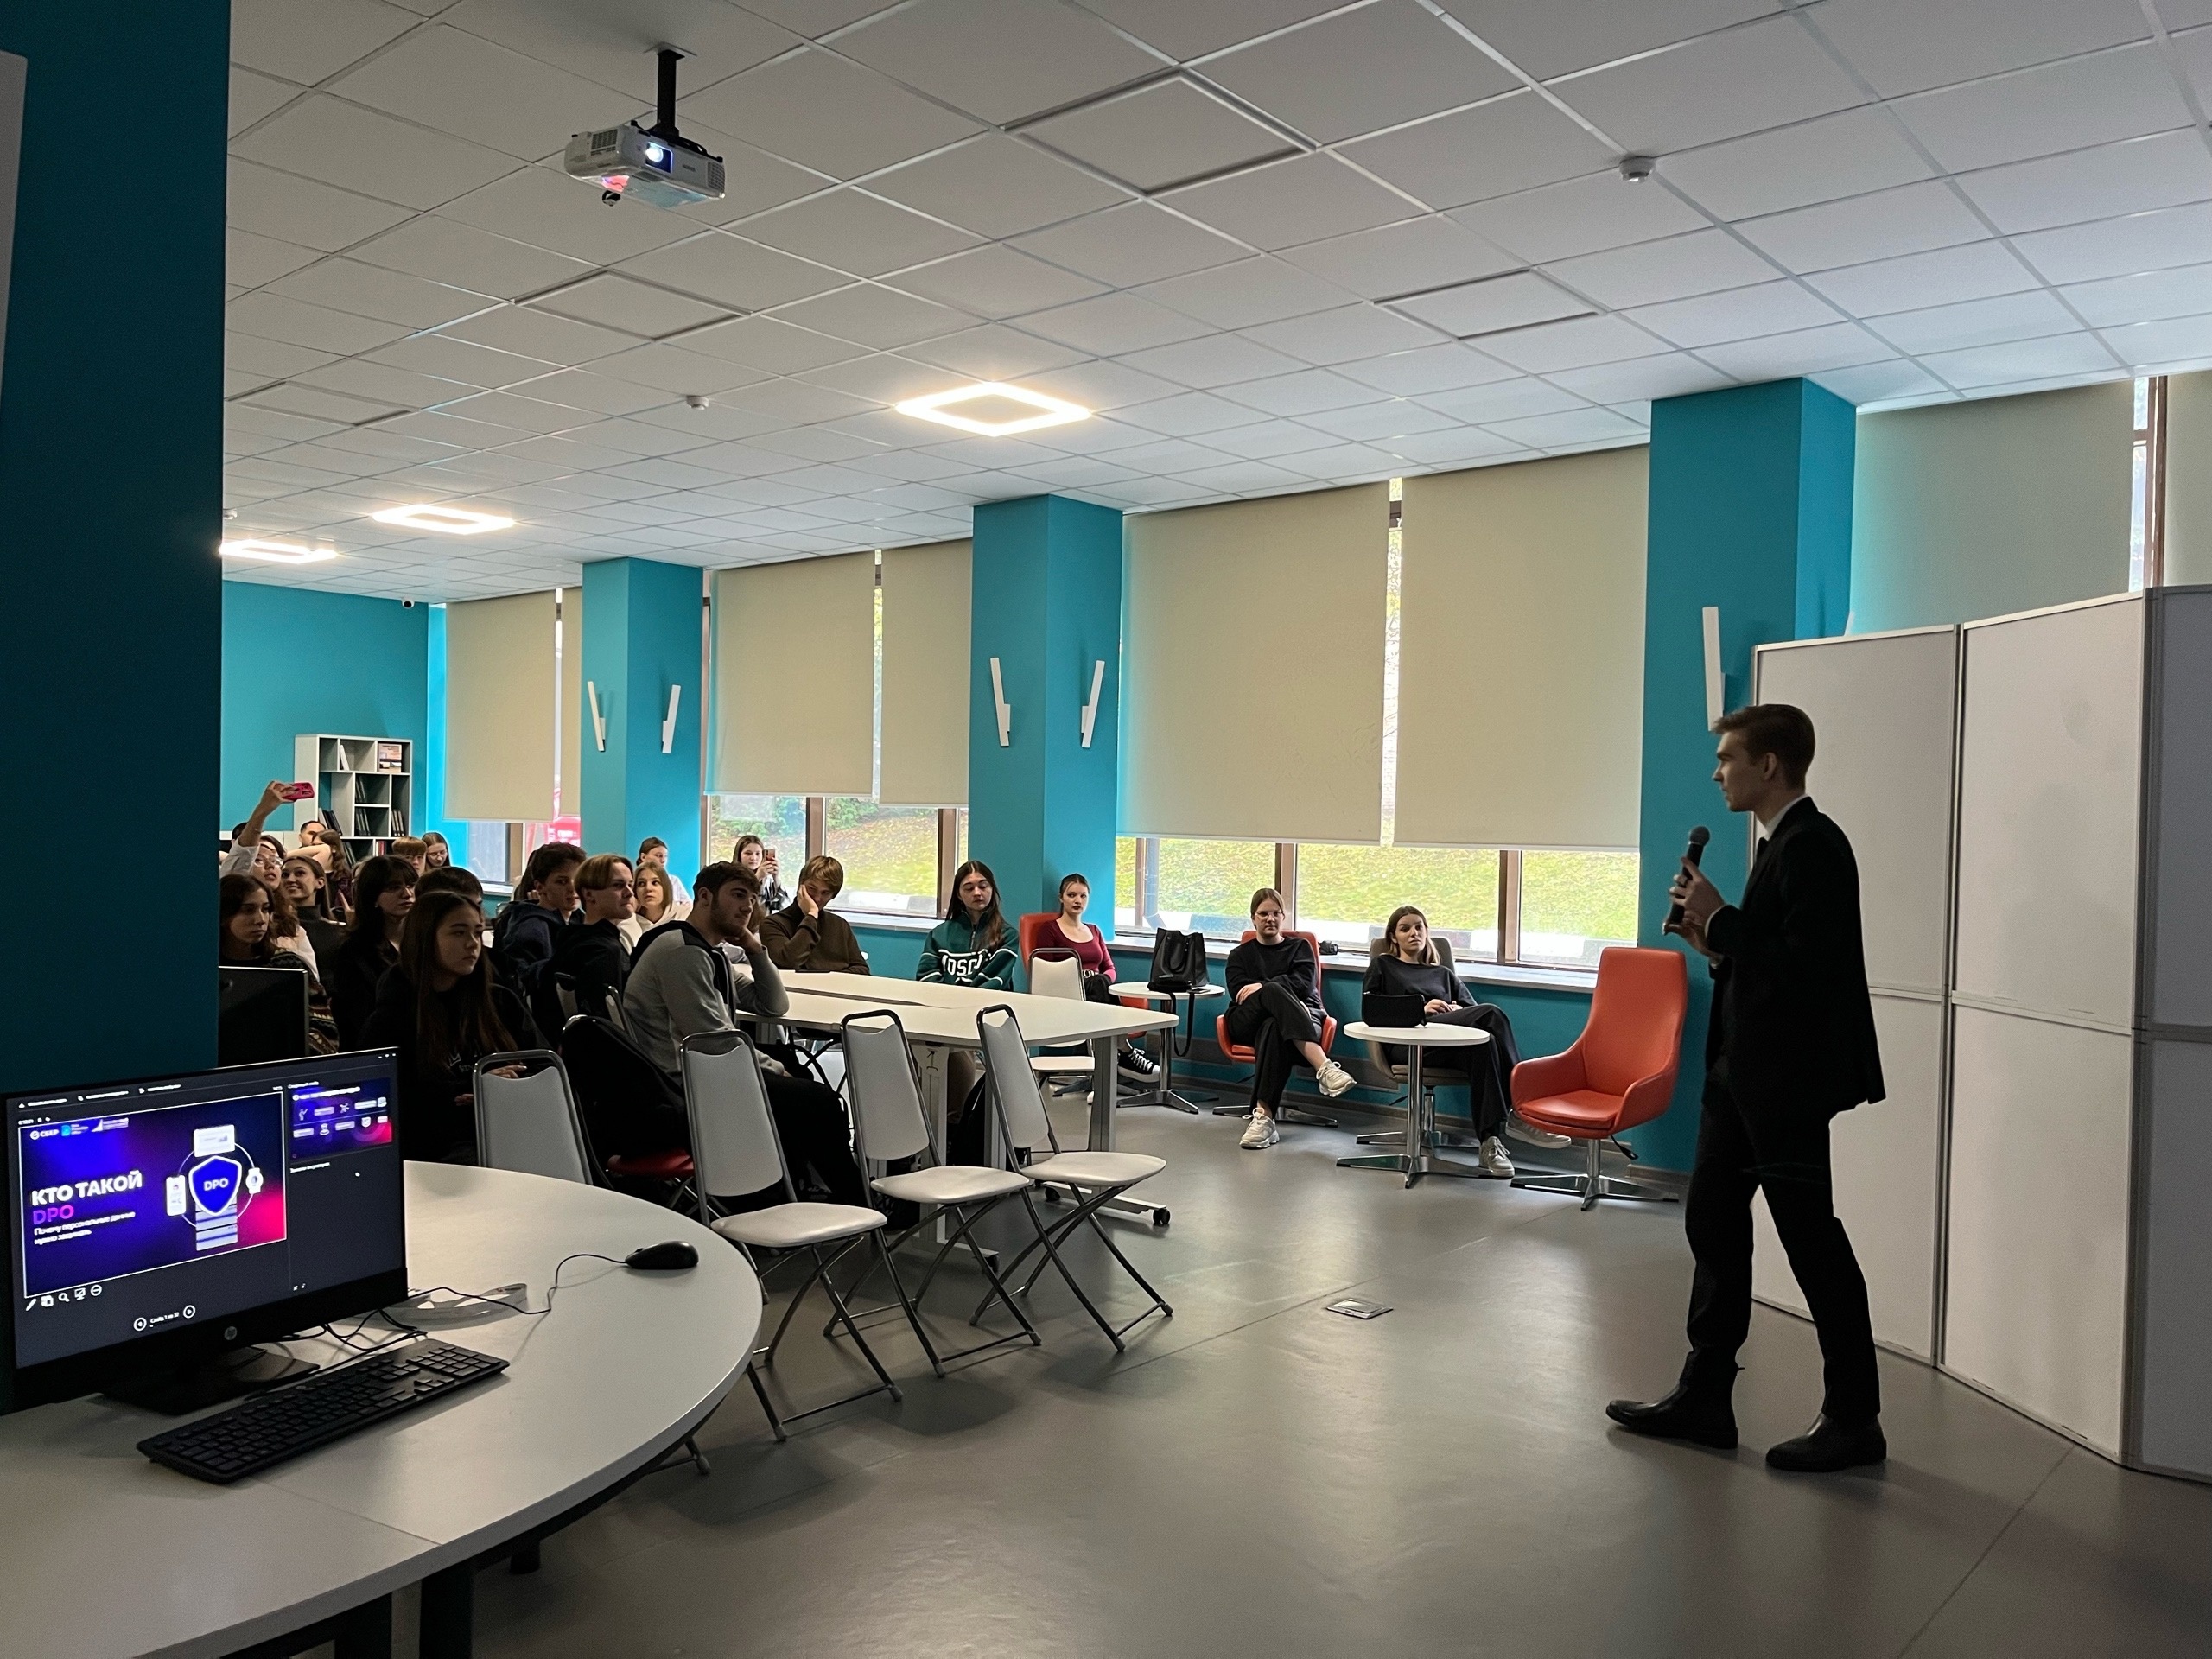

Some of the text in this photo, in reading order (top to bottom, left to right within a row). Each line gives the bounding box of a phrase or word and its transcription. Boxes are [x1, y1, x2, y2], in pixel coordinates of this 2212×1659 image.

[31, 1169, 143, 1206] КТО ТАКОЙ
[203, 1177, 229, 1192] DPO
[33, 1205, 74, 1224] DPO
